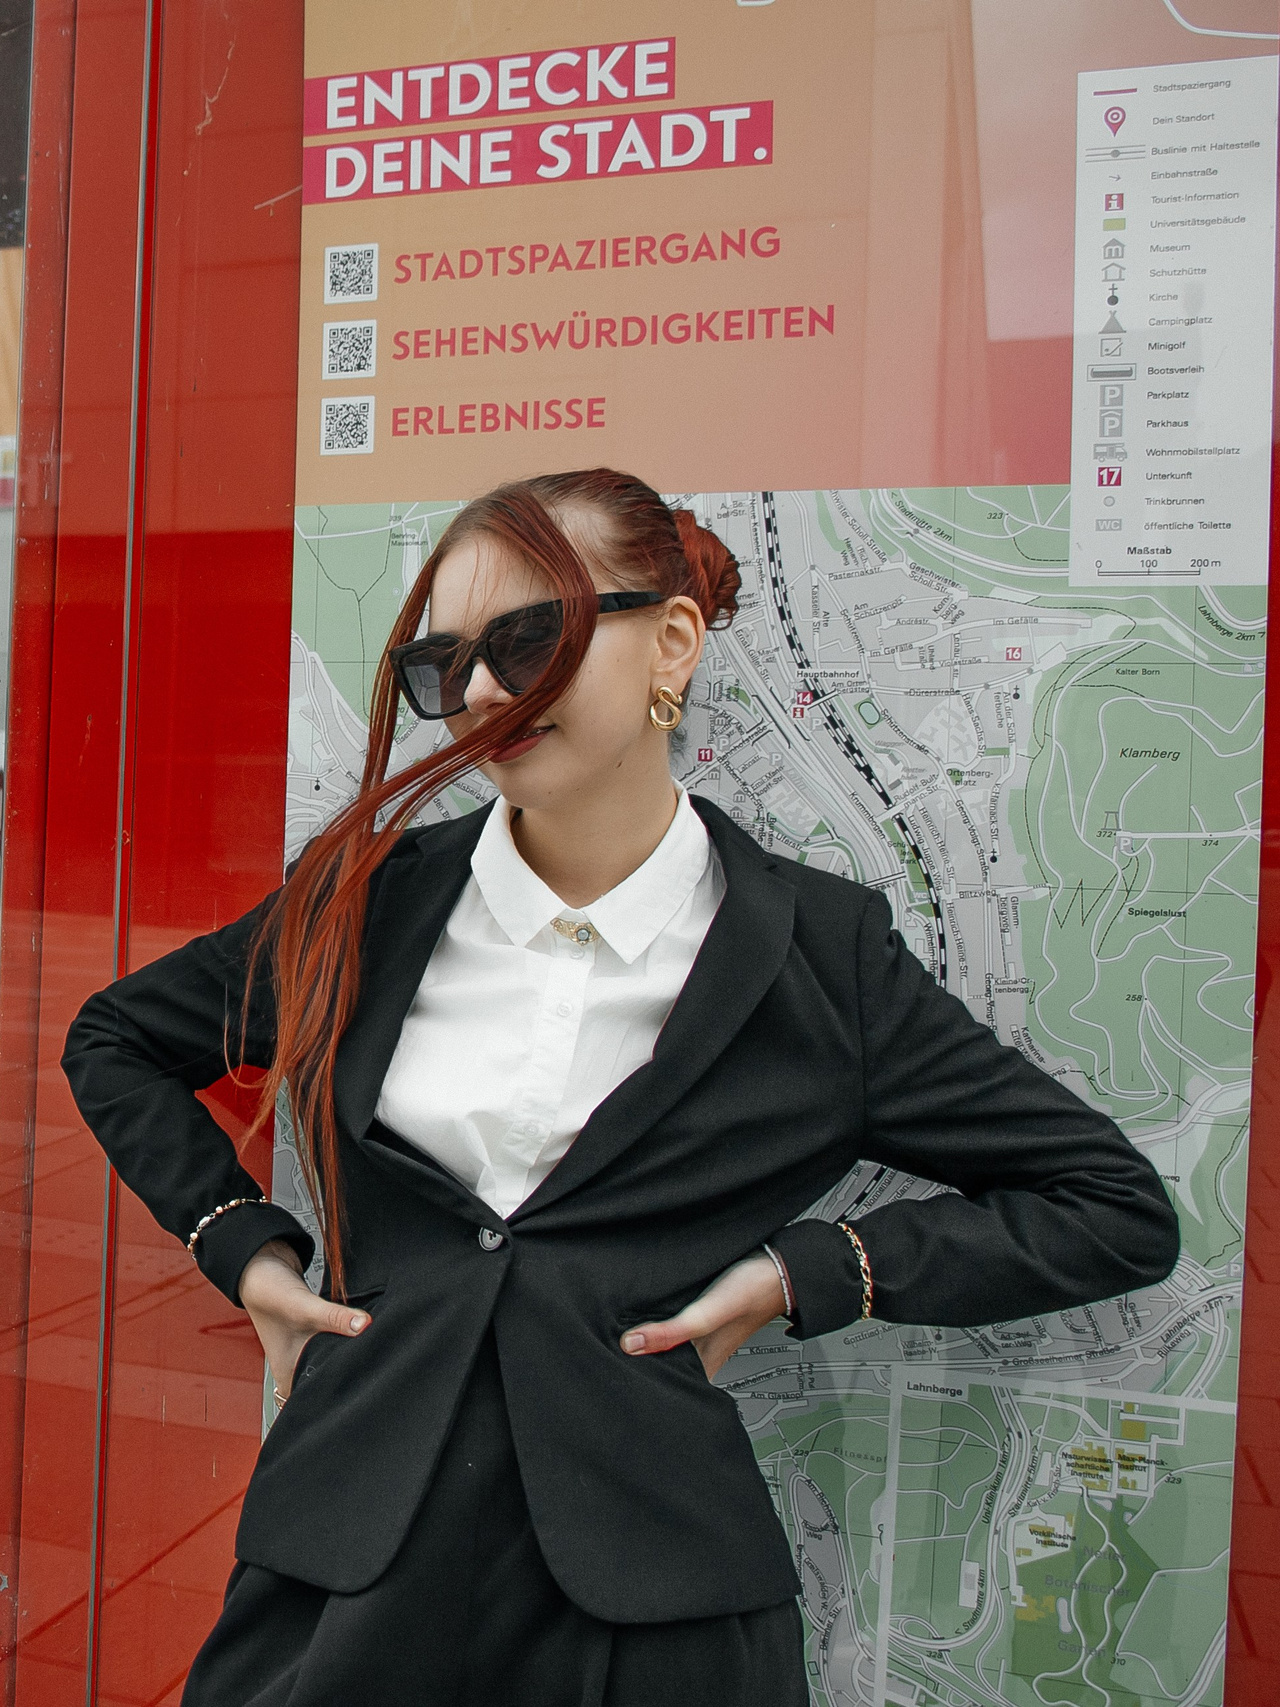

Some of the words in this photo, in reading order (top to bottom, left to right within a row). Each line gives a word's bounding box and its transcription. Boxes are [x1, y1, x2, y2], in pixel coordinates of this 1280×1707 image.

[325, 40, 670, 129] ENTDECKE
[1153, 79, 1231, 93] Stadtspaziergang
[1153, 117, 1173, 125] Dein
[1176, 113, 1215, 123] Standort
[325, 129, 513, 198] DEINE
[536, 107, 769, 179] STADT.
[1151, 146, 1187, 156] Buslinie
[1210, 141, 1260, 151] Haltestelle
[1151, 168, 1218, 179] Einbahnstraße
[1151, 191, 1239, 204] Tourist-Information
[1150, 216, 1246, 229] Universitätsgebäude
[1150, 244, 1191, 252] Museum
[393, 226, 782, 285] STADTSPAZIERGANG
[1149, 268, 1206, 277] Schutzhütte
[1149, 293, 1178, 301] Kirche
[1148, 316, 1213, 327] Campingplatz
[392, 304, 836, 361] SEHENSWÜRDIGKEITEN
[1148, 341, 1186, 351] Minigolf
[1147, 365, 1205, 375] Bootsverleih
[1147, 391, 1189, 401] Parkplatz
[391, 398, 606, 437] ERLEBNISSE
[1147, 419, 1189, 428] Parkhaus
[1146, 446, 1240, 457] Wohnmobilstellplatz
[1099, 469, 1120, 484] 17
[1146, 472, 1192, 480] Unterkunft
[1145, 497, 1205, 505] Trinkbrunnen
[894, 499, 933, 532] Stadtmitte
[934, 528, 953, 542] 2km
[987, 512, 1004, 520] 323
[1098, 520, 1120, 530] WC
[1144, 522, 1194, 530] öffentliche
[1198, 521, 1231, 530] Toilette
[1127, 547, 1172, 555] Maßstab
[1096, 560, 1102, 568] 0
[1140, 559, 1158, 568] 100
[908, 561, 962, 589] Geschwister-
[812, 585, 820, 620] Kasseler
[853, 602, 869, 611] Am
[822, 611, 830, 627] Alte
[1007, 617, 1038, 625] Gefälle
[1197, 605, 1233, 638] Lahnberge
[1235, 631, 1256, 641] 2km
[1007, 649, 1020, 660] 16
[798, 693, 811, 704] 14
[699, 750, 712, 760] 11
[1119, 748, 1180, 761] Klamberg
[1128, 908, 1186, 918] Spiegelslust
[1160, 1310, 1201, 1343] Lahnberge
[907, 1381, 963, 1396] Lahnberge
[1165, 1476, 1182, 1485] 329
